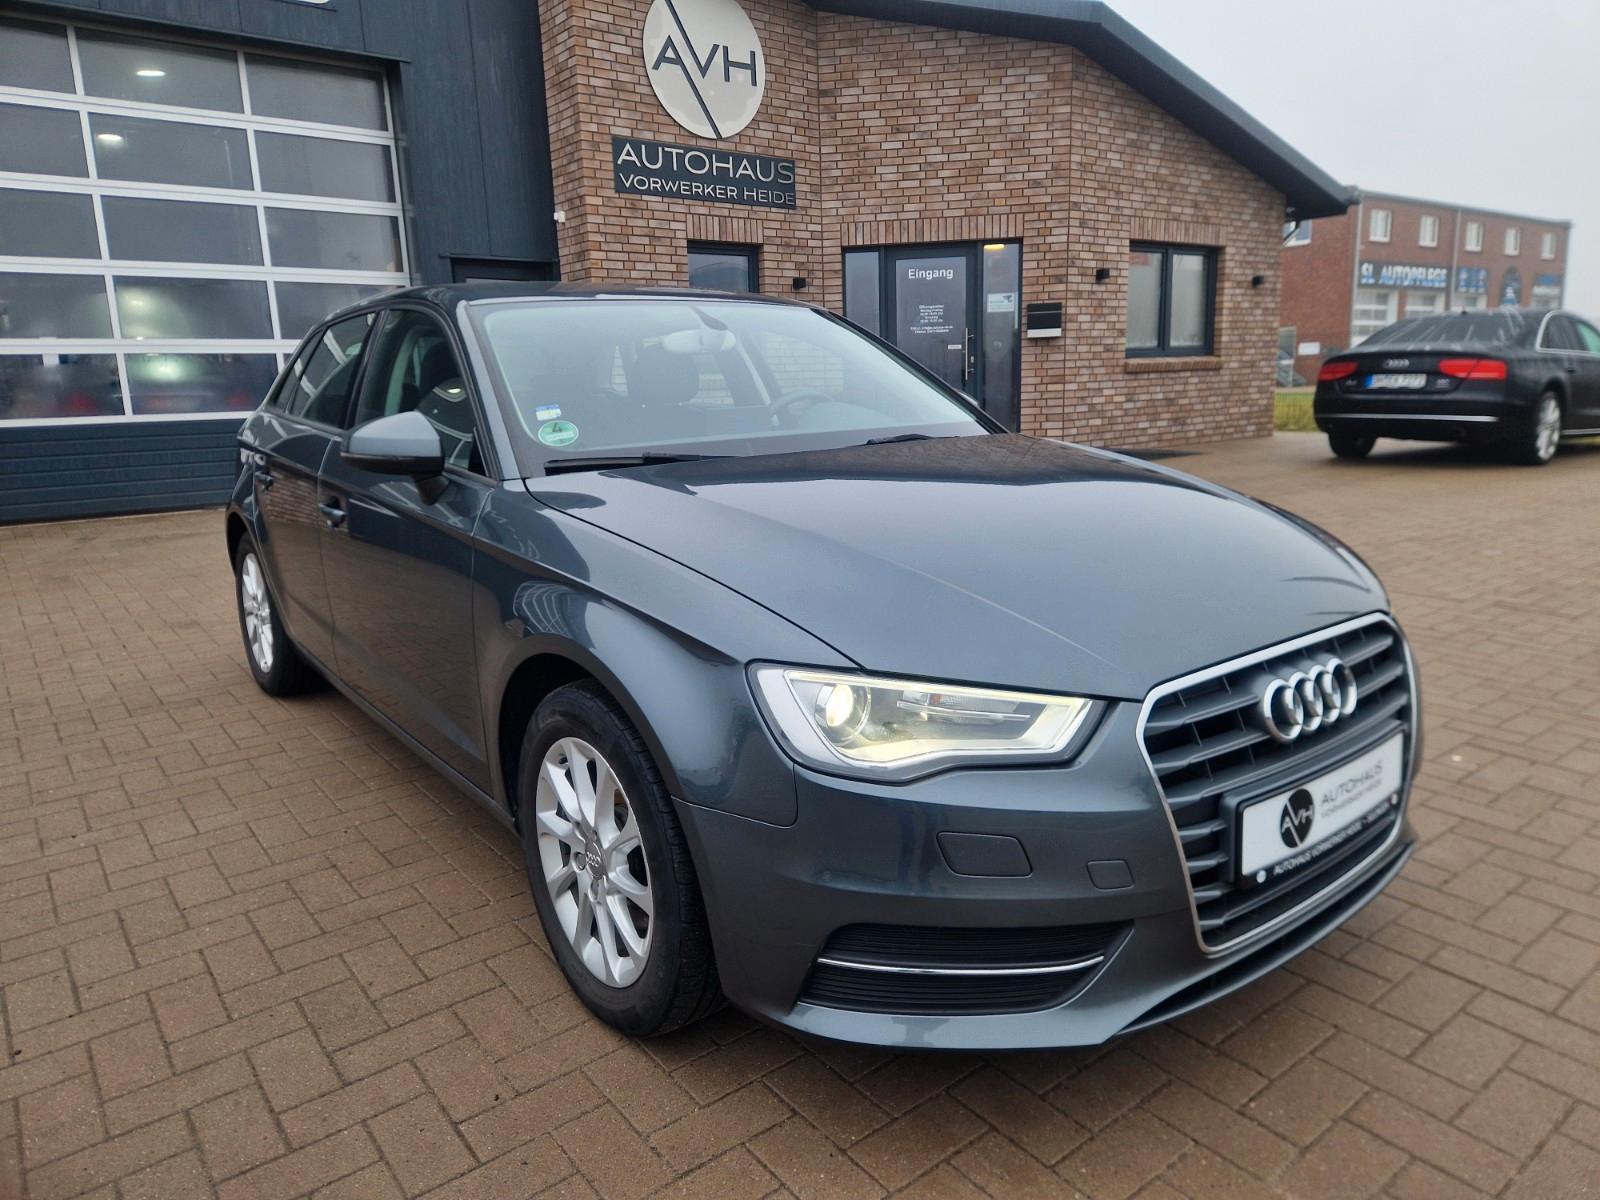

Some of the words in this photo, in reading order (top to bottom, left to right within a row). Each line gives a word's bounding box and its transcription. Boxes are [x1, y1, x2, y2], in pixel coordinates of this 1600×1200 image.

[651, 33, 758, 87] AVH
[617, 141, 794, 184] AUTOHAUS
[618, 173, 738, 200] VORWERKER
[743, 187, 795, 206] HEIDE
[908, 268, 954, 280] Eingang
[1322, 760, 1383, 804] AUTOHAUS
[1282, 805, 1313, 833] AVH
